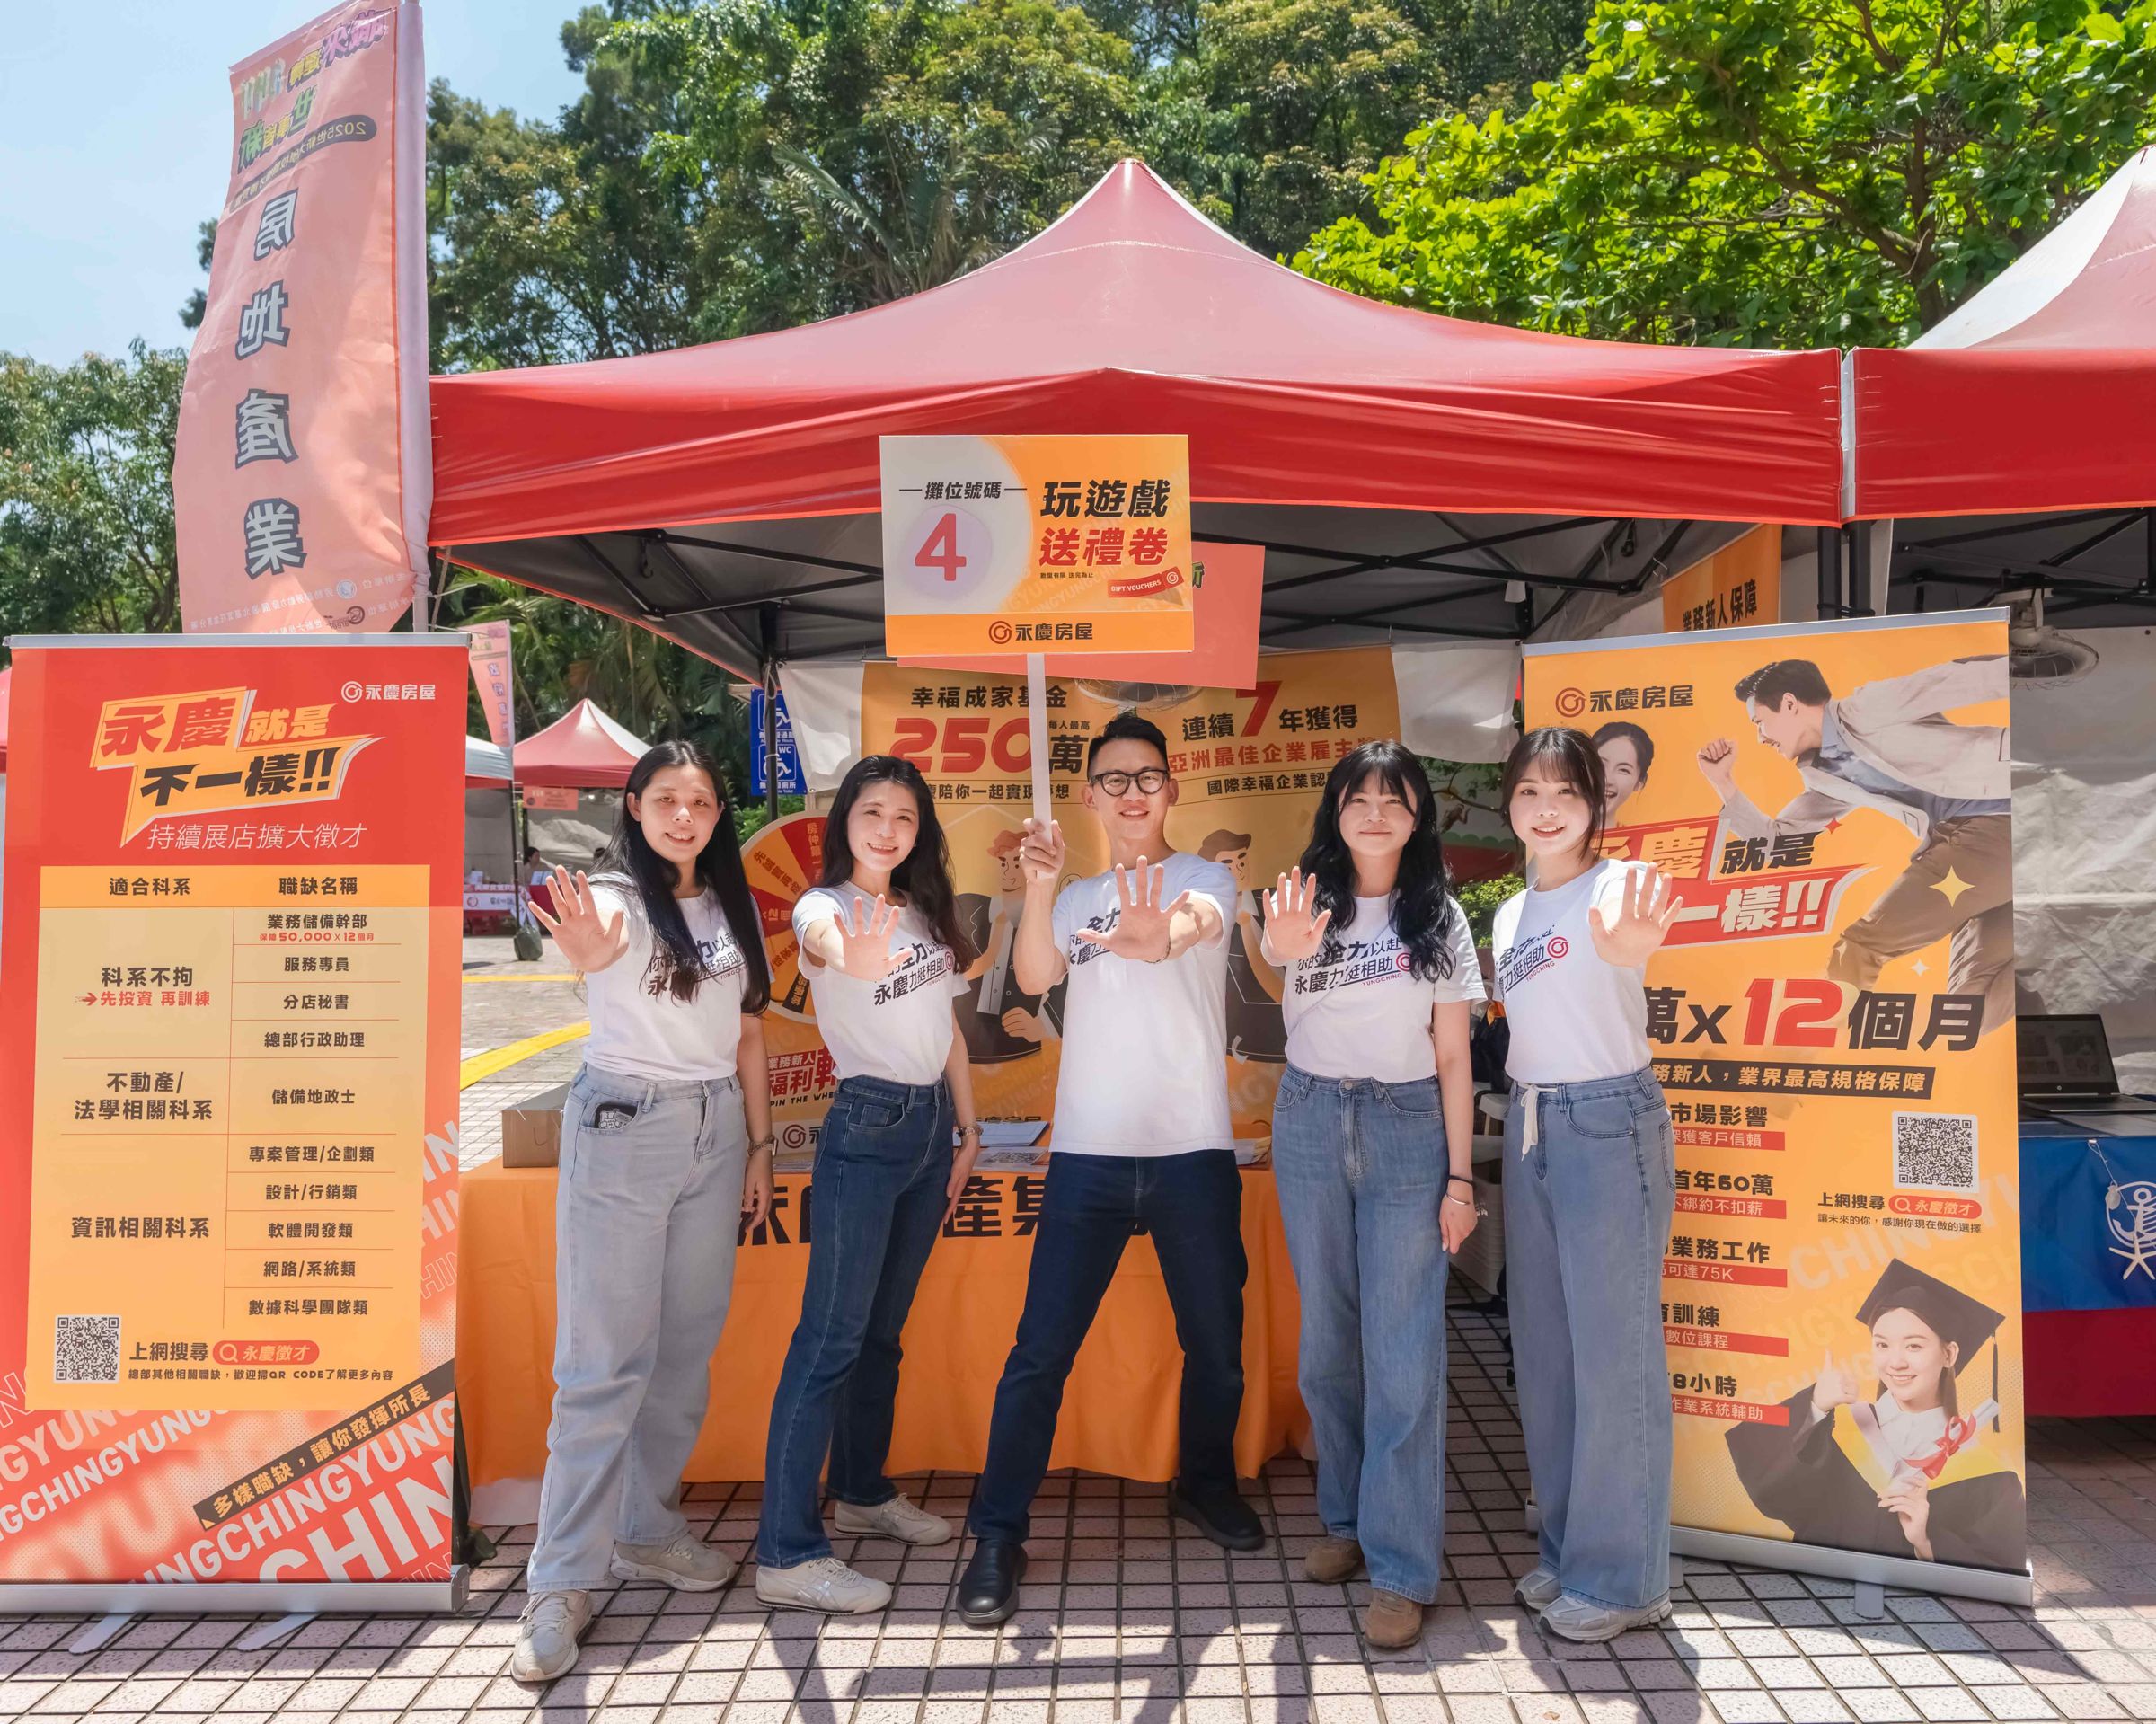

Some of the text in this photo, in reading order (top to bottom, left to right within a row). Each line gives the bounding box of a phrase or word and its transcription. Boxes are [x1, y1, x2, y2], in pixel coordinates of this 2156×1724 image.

[925, 482, 1002, 500] 攤位號碼
[1040, 479, 1171, 518] 玩遊戲
[915, 513, 967, 581] 4
[1039, 527, 1168, 567] 送禮卷
[1127, 579, 1162, 591] VOUCHERS
[1683, 579, 1757, 631] 業務新人保障
[1015, 623, 1093, 641] 永慶房屋
[365, 684, 436, 701] 永慶房屋
[1589, 685, 1694, 712] 永慶房屋
[1182, 680, 1358, 741] 連續7年獲得
[99, 696, 337, 756] 永慶就是
[1049, 720, 1090, 730] 每人最高
[1168, 737, 1377, 774] 亞洲最佳企業雇主
[140, 747, 343, 807] 不一樣!!
[1207, 772, 1330, 796] 國際幸福企業認
[928, 783, 1070, 800] 陪你一起實現想
[146, 823, 367, 850] 持續展店擴大徵才
[110, 877, 191, 897] 適合科系
[278, 876, 358, 896] 職缺名稱
[268, 914, 367, 929] 業務儲備幹部
[284, 956, 350, 973] 服務專員
[102, 967, 193, 987] 科系不拘
[874, 956, 945, 1005] 永慶力挺相助
[1294, 956, 1393, 995] 永慶力挺相助
[1362, 973, 1402, 986] YUNGCHING
[100, 991, 210, 1007] 先投資 再訓練
[283, 994, 349, 1011] 分店秘書
[264, 1031, 366, 1048] 總部行政助理
[768, 1052, 815, 1069] 業務新人
[106, 1071, 183, 1093] 不動產/
[271, 1088, 356, 1106] 儲備地政士
[791, 1095, 808, 1105] THE
[74, 1099, 213, 1121] 法學相關科系
[1670, 1102, 1767, 1127] 市場影響
[249, 1145, 376, 1163] 專案管理/企劃類
[265, 1184, 358, 1201] 設計/行銷類
[1817, 1192, 1974, 1216] 上網搜尋 永慶徵才
[71, 1216, 210, 1240] 資訊相關科系
[268, 1222, 354, 1239] 軟體開發類
[1817, 1213, 1981, 1233] 讓未來的你，感謝你現在做的選擇
[1665, 1236, 1770, 1263] 業務工作
[263, 1260, 357, 1278] 網路/系統類
[248, 1299, 368, 1317] 數據科學團隊類
[1666, 1330, 1728, 1348] 數位課程
[129, 1341, 311, 1362] 上網搜尋 永慶徵才
[1668, 1373, 1737, 1397] 8小時
